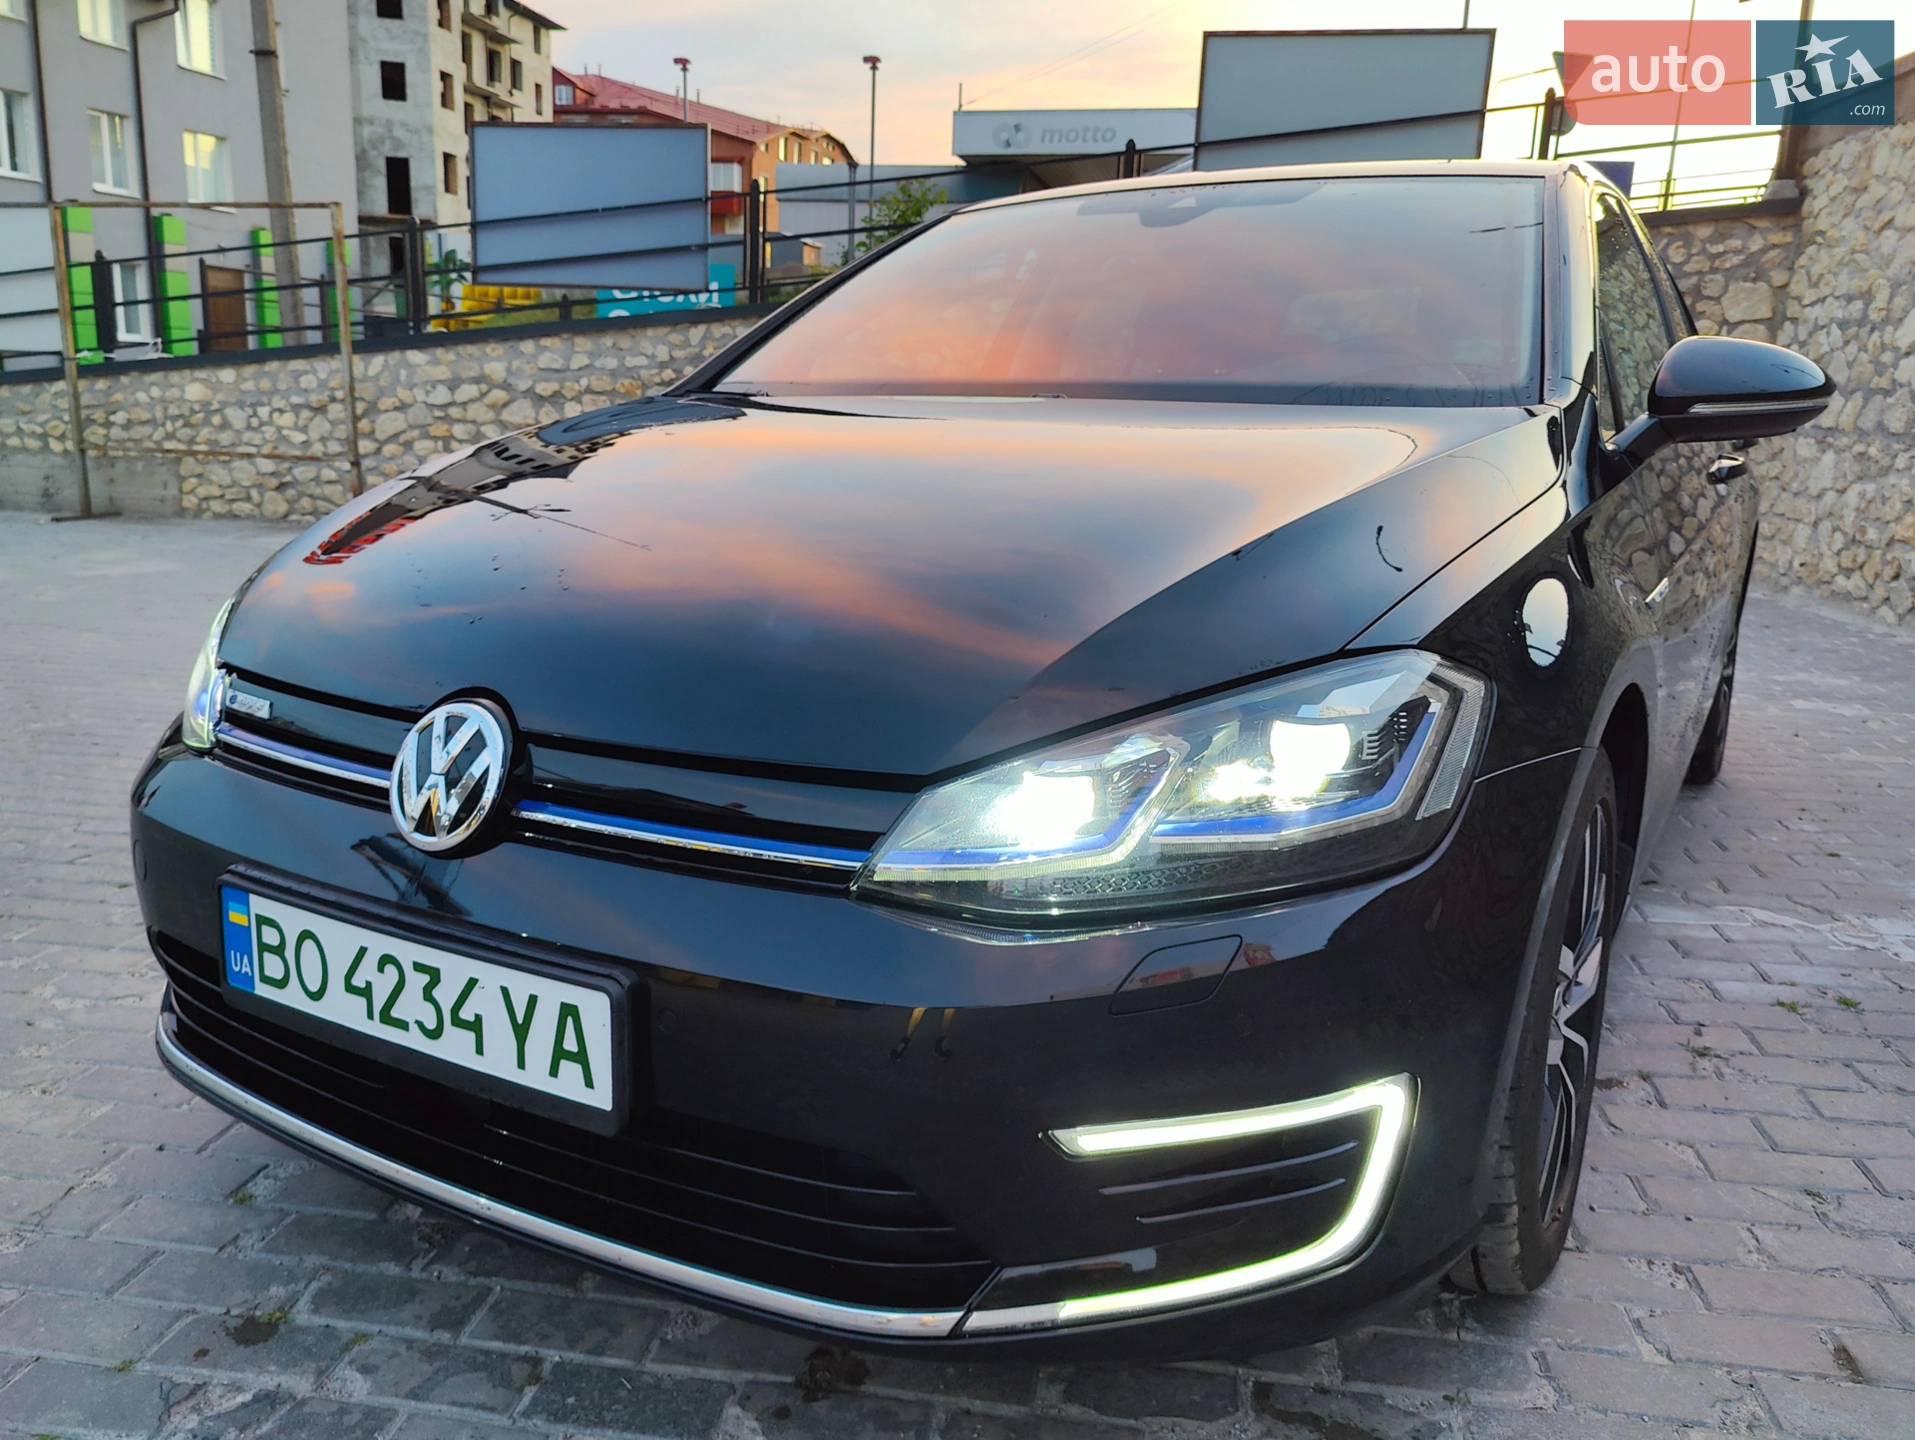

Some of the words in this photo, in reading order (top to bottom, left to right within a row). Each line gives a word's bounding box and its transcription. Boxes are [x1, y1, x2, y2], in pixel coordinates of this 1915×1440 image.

[1039, 123, 1117, 145] motto
[230, 949, 253, 978] UA
[254, 912, 329, 1002] BO
[343, 945, 485, 1057] 4234
[499, 984, 596, 1090] YA
